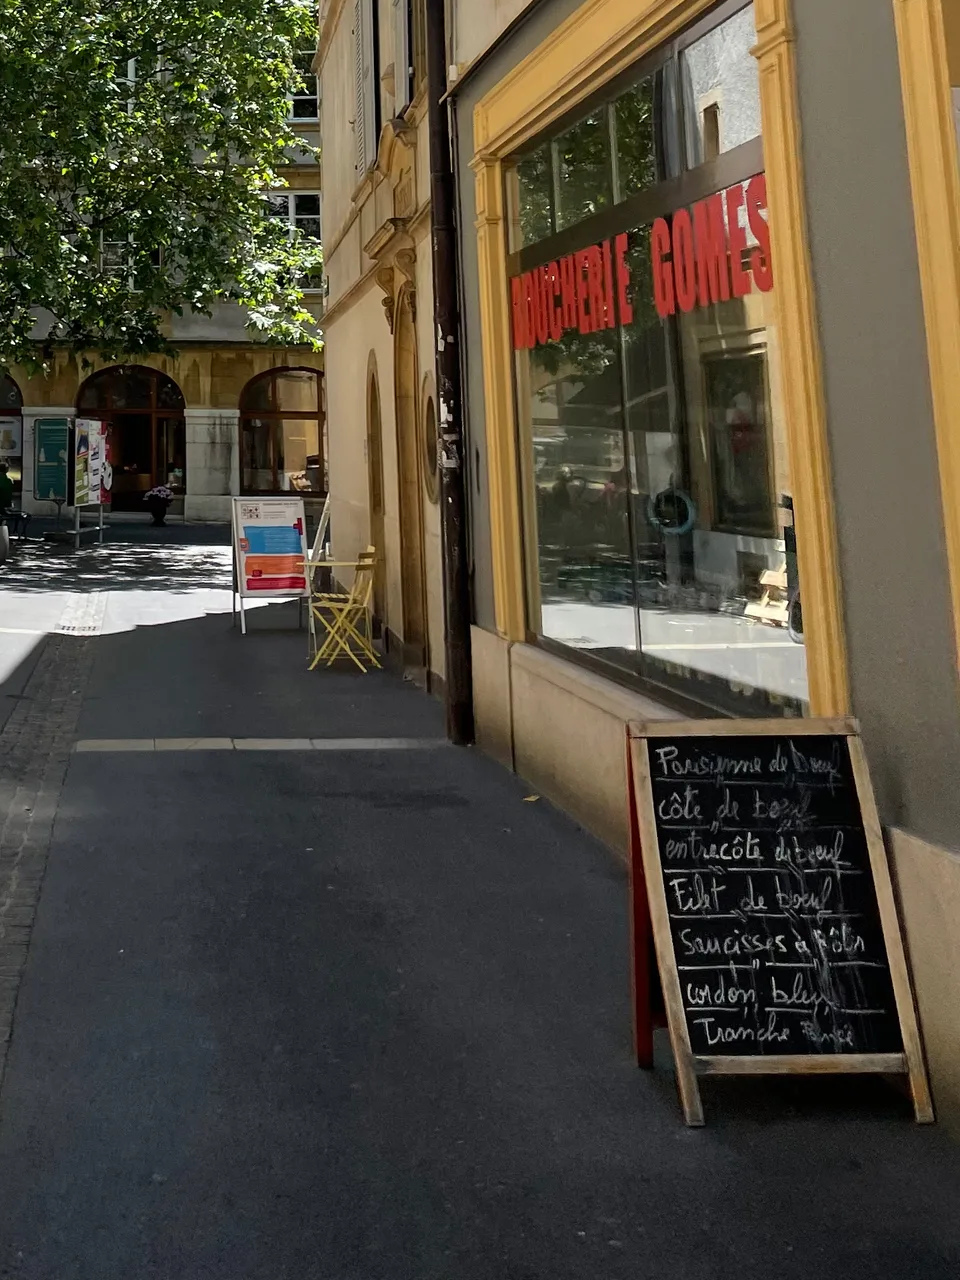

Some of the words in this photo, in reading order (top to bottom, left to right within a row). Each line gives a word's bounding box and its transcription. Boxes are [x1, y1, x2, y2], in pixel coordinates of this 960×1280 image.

[510, 231, 634, 350] BOUCHERIE
[651, 172, 775, 318] GOMES
[768, 744, 788, 772] de
[658, 785, 703, 820] côte
[716, 787, 740, 820] de
[665, 830, 764, 861] entrecôte
[669, 873, 726, 911] Filet
[740, 875, 768, 910] de
[680, 928, 788, 956] Saucisses
[692, 1011, 790, 1046] Tranche
